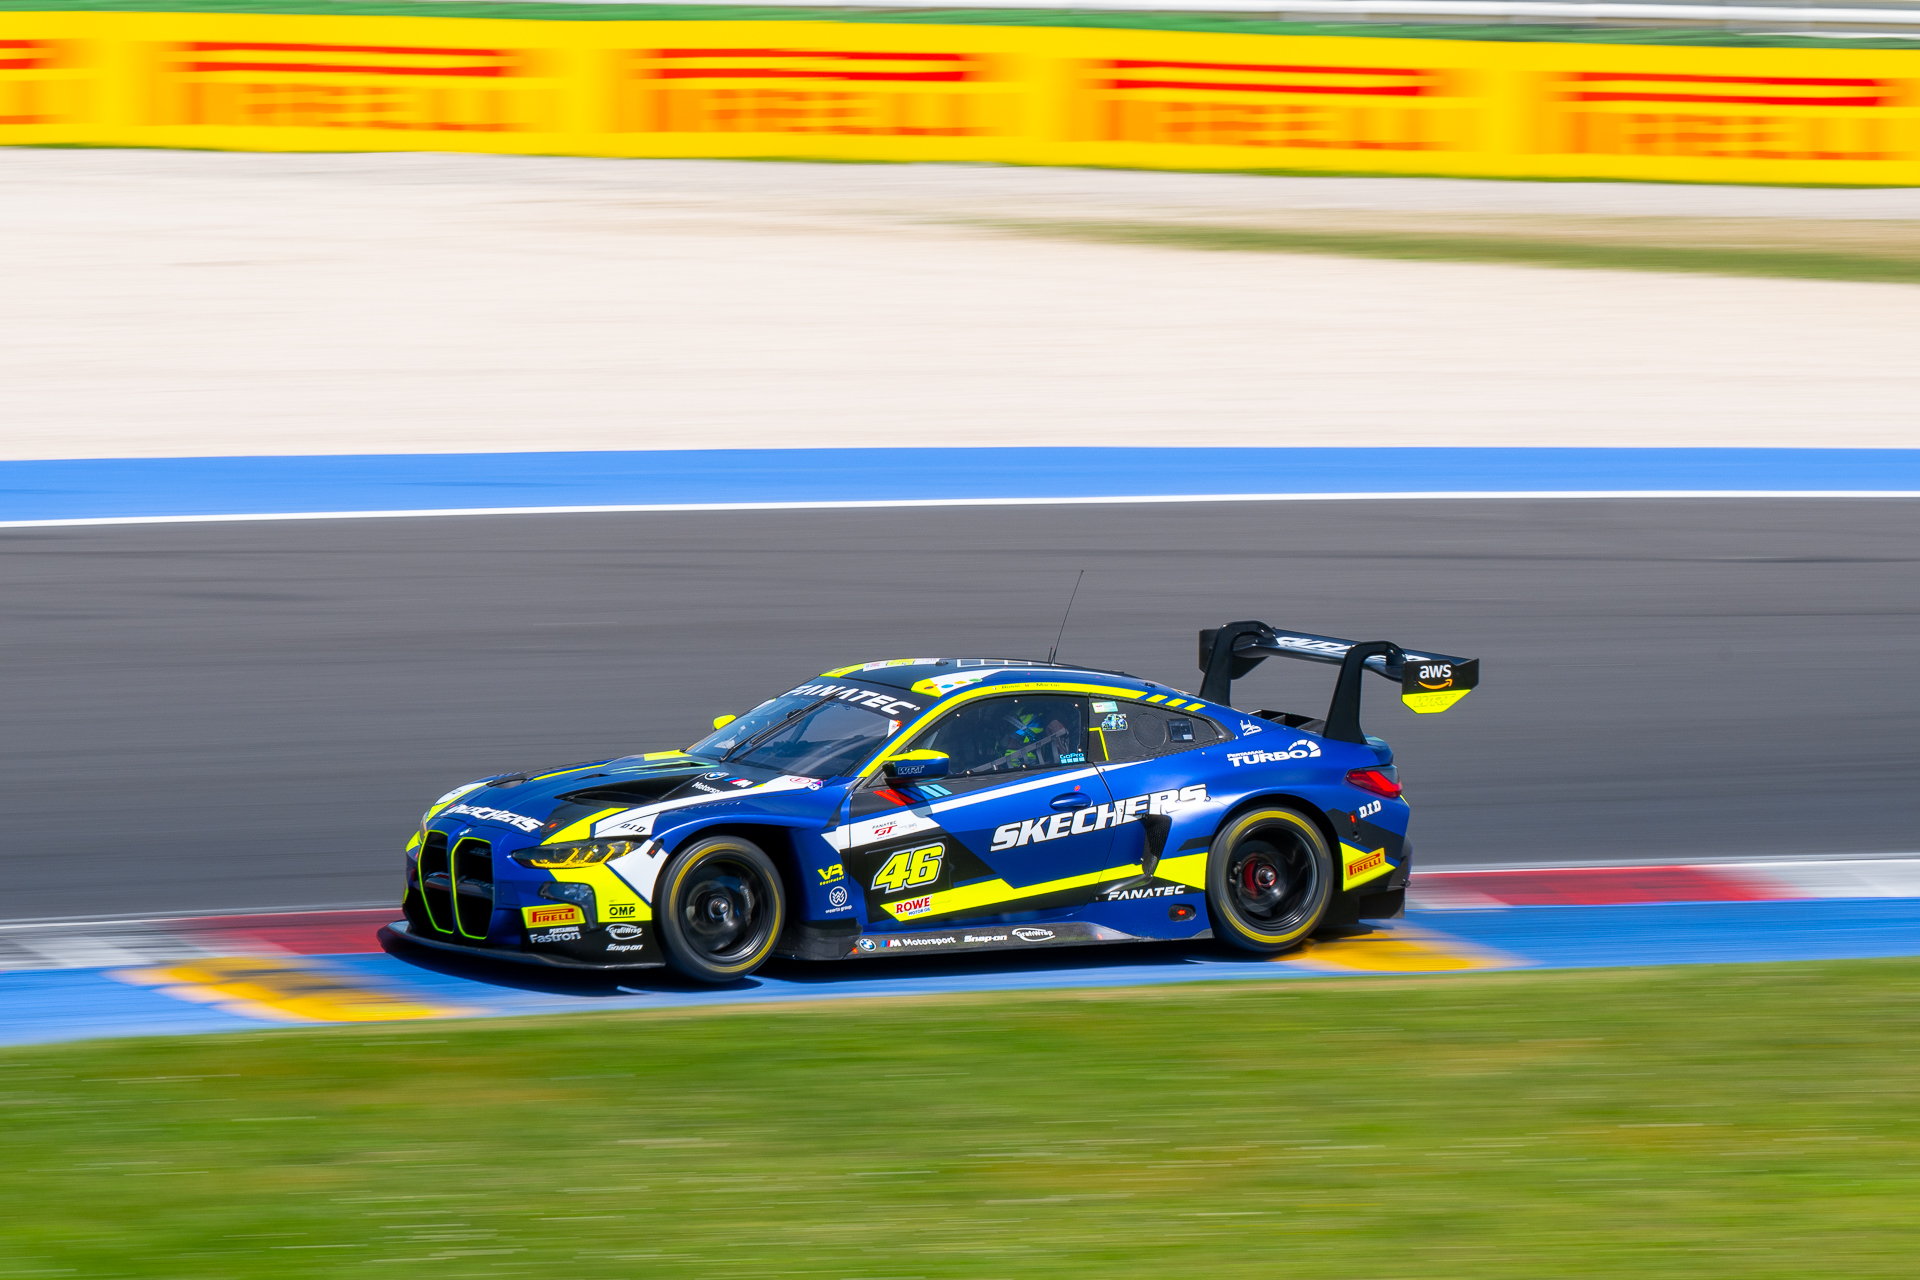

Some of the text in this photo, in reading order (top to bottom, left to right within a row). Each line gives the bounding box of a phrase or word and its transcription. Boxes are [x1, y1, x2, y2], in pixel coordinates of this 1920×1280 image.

[1419, 664, 1452, 679] aws
[779, 684, 917, 715] FANATEC
[1227, 749, 1309, 768] TURBO
[898, 765, 925, 775] WRT
[989, 783, 1213, 852] SKECHERS
[870, 842, 946, 894] 46
[1349, 853, 1381, 876] PIRELLI
[1107, 884, 1186, 901] FANATEC
[609, 906, 636, 916] OMP
[895, 896, 931, 914] ROWE
[532, 908, 575, 923] PIRELLI
[529, 931, 581, 944] Fastron
[902, 936, 956, 946] Motorsport
[963, 934, 1008, 943] Snap-on
